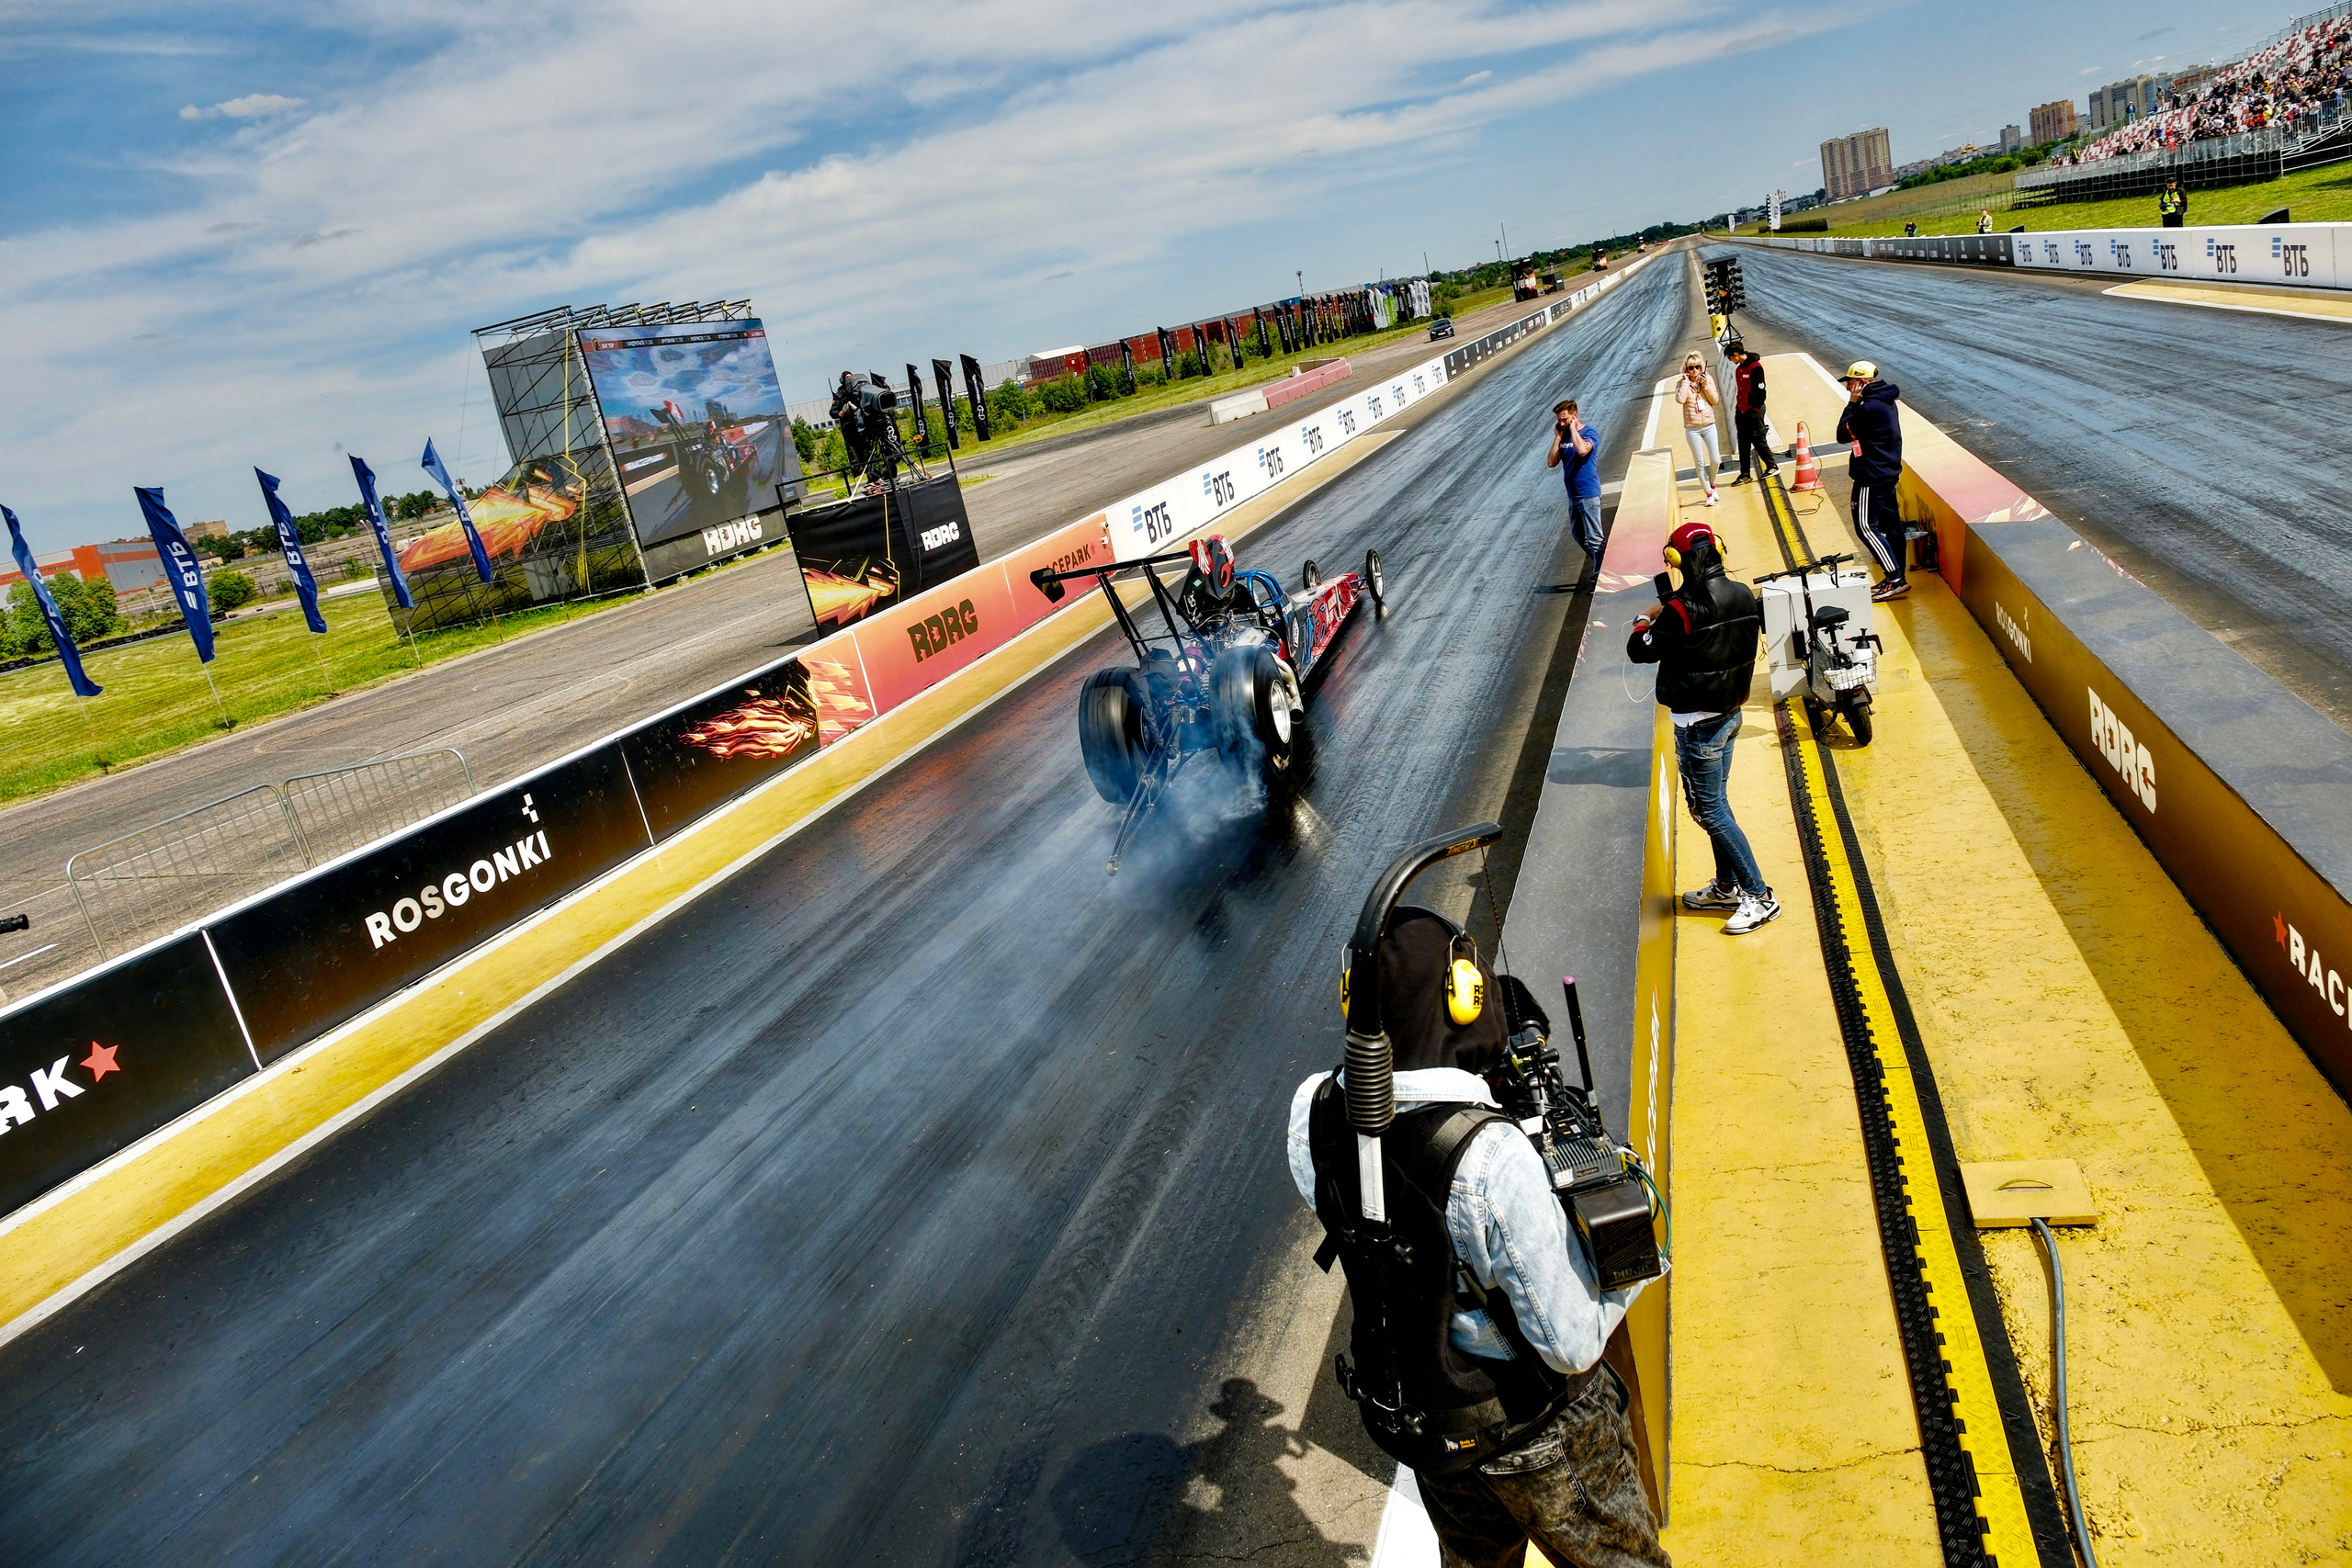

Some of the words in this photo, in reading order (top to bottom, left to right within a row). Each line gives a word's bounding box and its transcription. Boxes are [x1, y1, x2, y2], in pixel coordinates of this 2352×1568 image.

[2079, 244, 2093, 265] ВТБ
[2116, 244, 2132, 267] ВТБ
[2160, 244, 2177, 270] ВТБ
[2215, 244, 2237, 273] ВТБ
[2282, 244, 2309, 276] ВТБ
[1342, 410, 1356, 434] ВТБ
[1308, 426, 1323, 454] ВТБ
[1266, 446, 1283, 479] ВТБ
[1212, 470, 1235, 507] ВТБ
[1144, 501, 1172, 544] ВТБ
[277, 522, 301, 565] ВТБ
[1046, 543, 1091, 573] CEPARK
[165, 540, 198, 587] ВТБ
[1996, 601, 2031, 664] ROSGONKI
[365, 829, 551, 950] ROSGONKI
